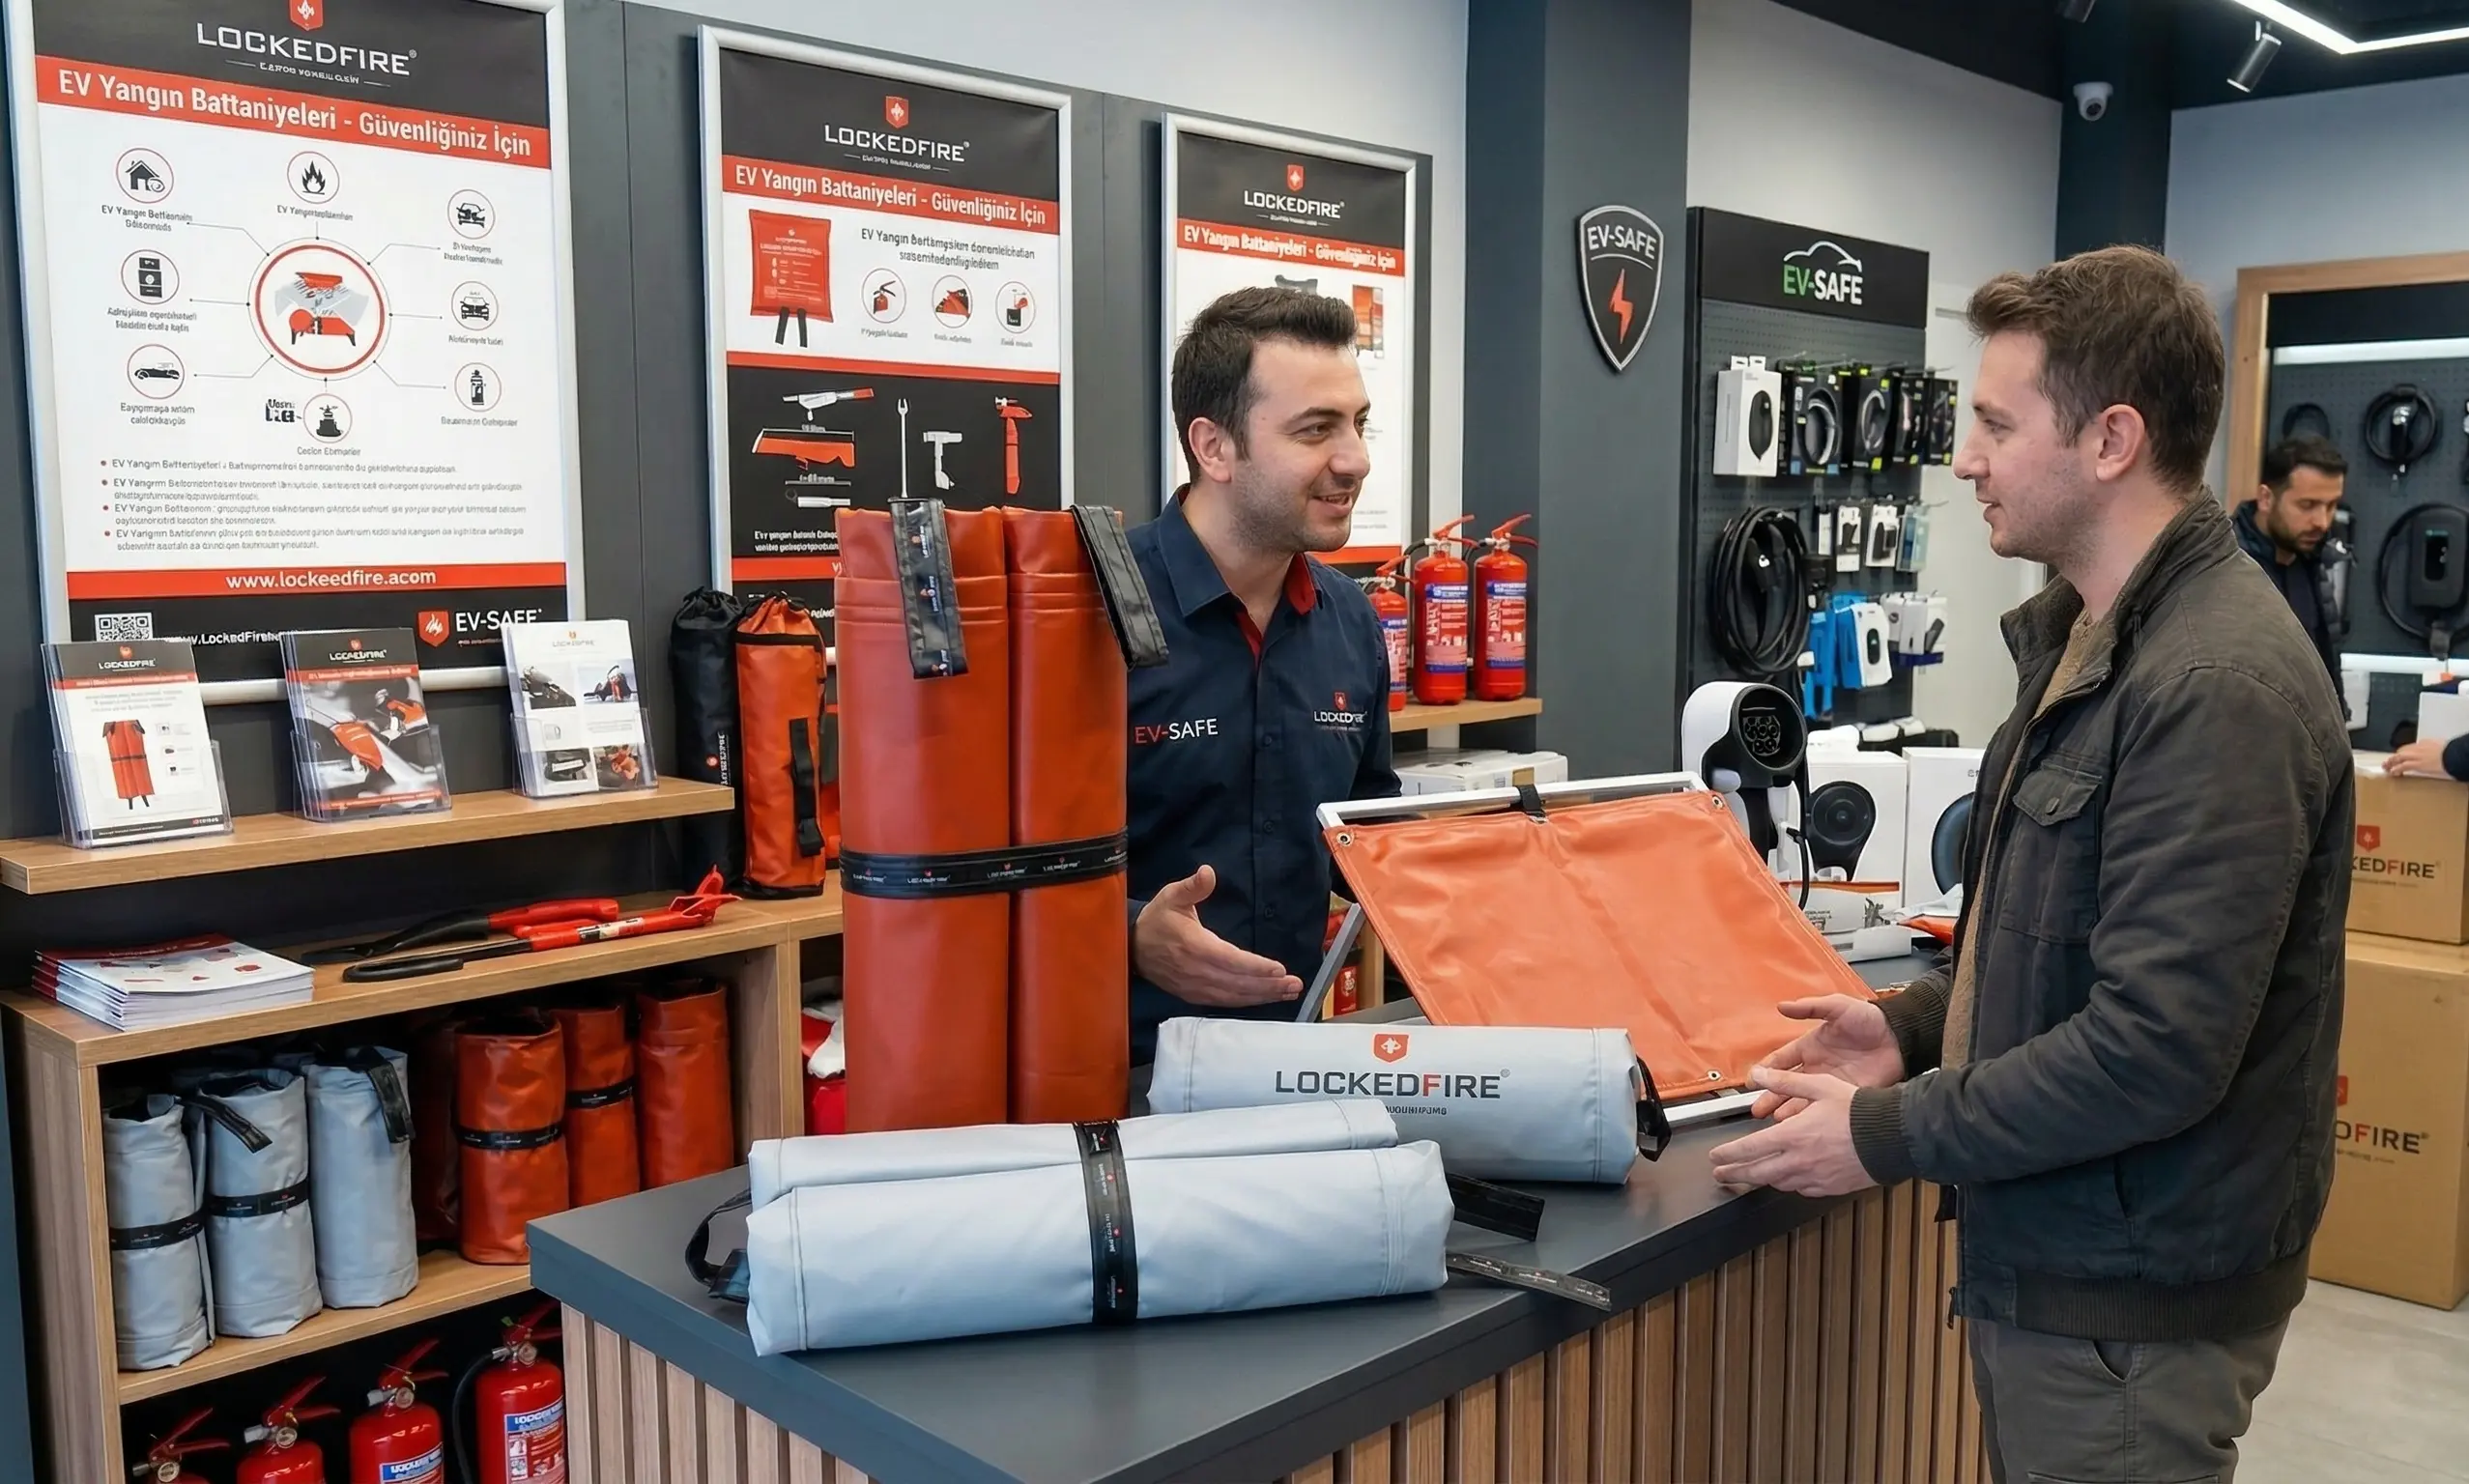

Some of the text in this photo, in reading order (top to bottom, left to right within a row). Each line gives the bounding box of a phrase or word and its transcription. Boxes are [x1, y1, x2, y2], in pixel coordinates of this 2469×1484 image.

[59, 68, 92, 97] EV
[191, 87, 336, 130] Battaniyeleri
[359, 111, 487, 151] Güvenliğiniz
[494, 124, 531, 159] İçin
[735, 164, 757, 186] EV
[821, 177, 917, 208] Battaniyeleri
[932, 191, 1018, 222] Güvenliğiniz
[861, 228, 875, 241] EV
[1184, 224, 1199, 243] EV
[1587, 224, 1657, 260] EV-SAFE
[1783, 263, 1863, 305] EV-SAFE
[225, 569, 437, 589] www.lockeedfire.acom
[1134, 718, 1219, 744] EV-SAFE
